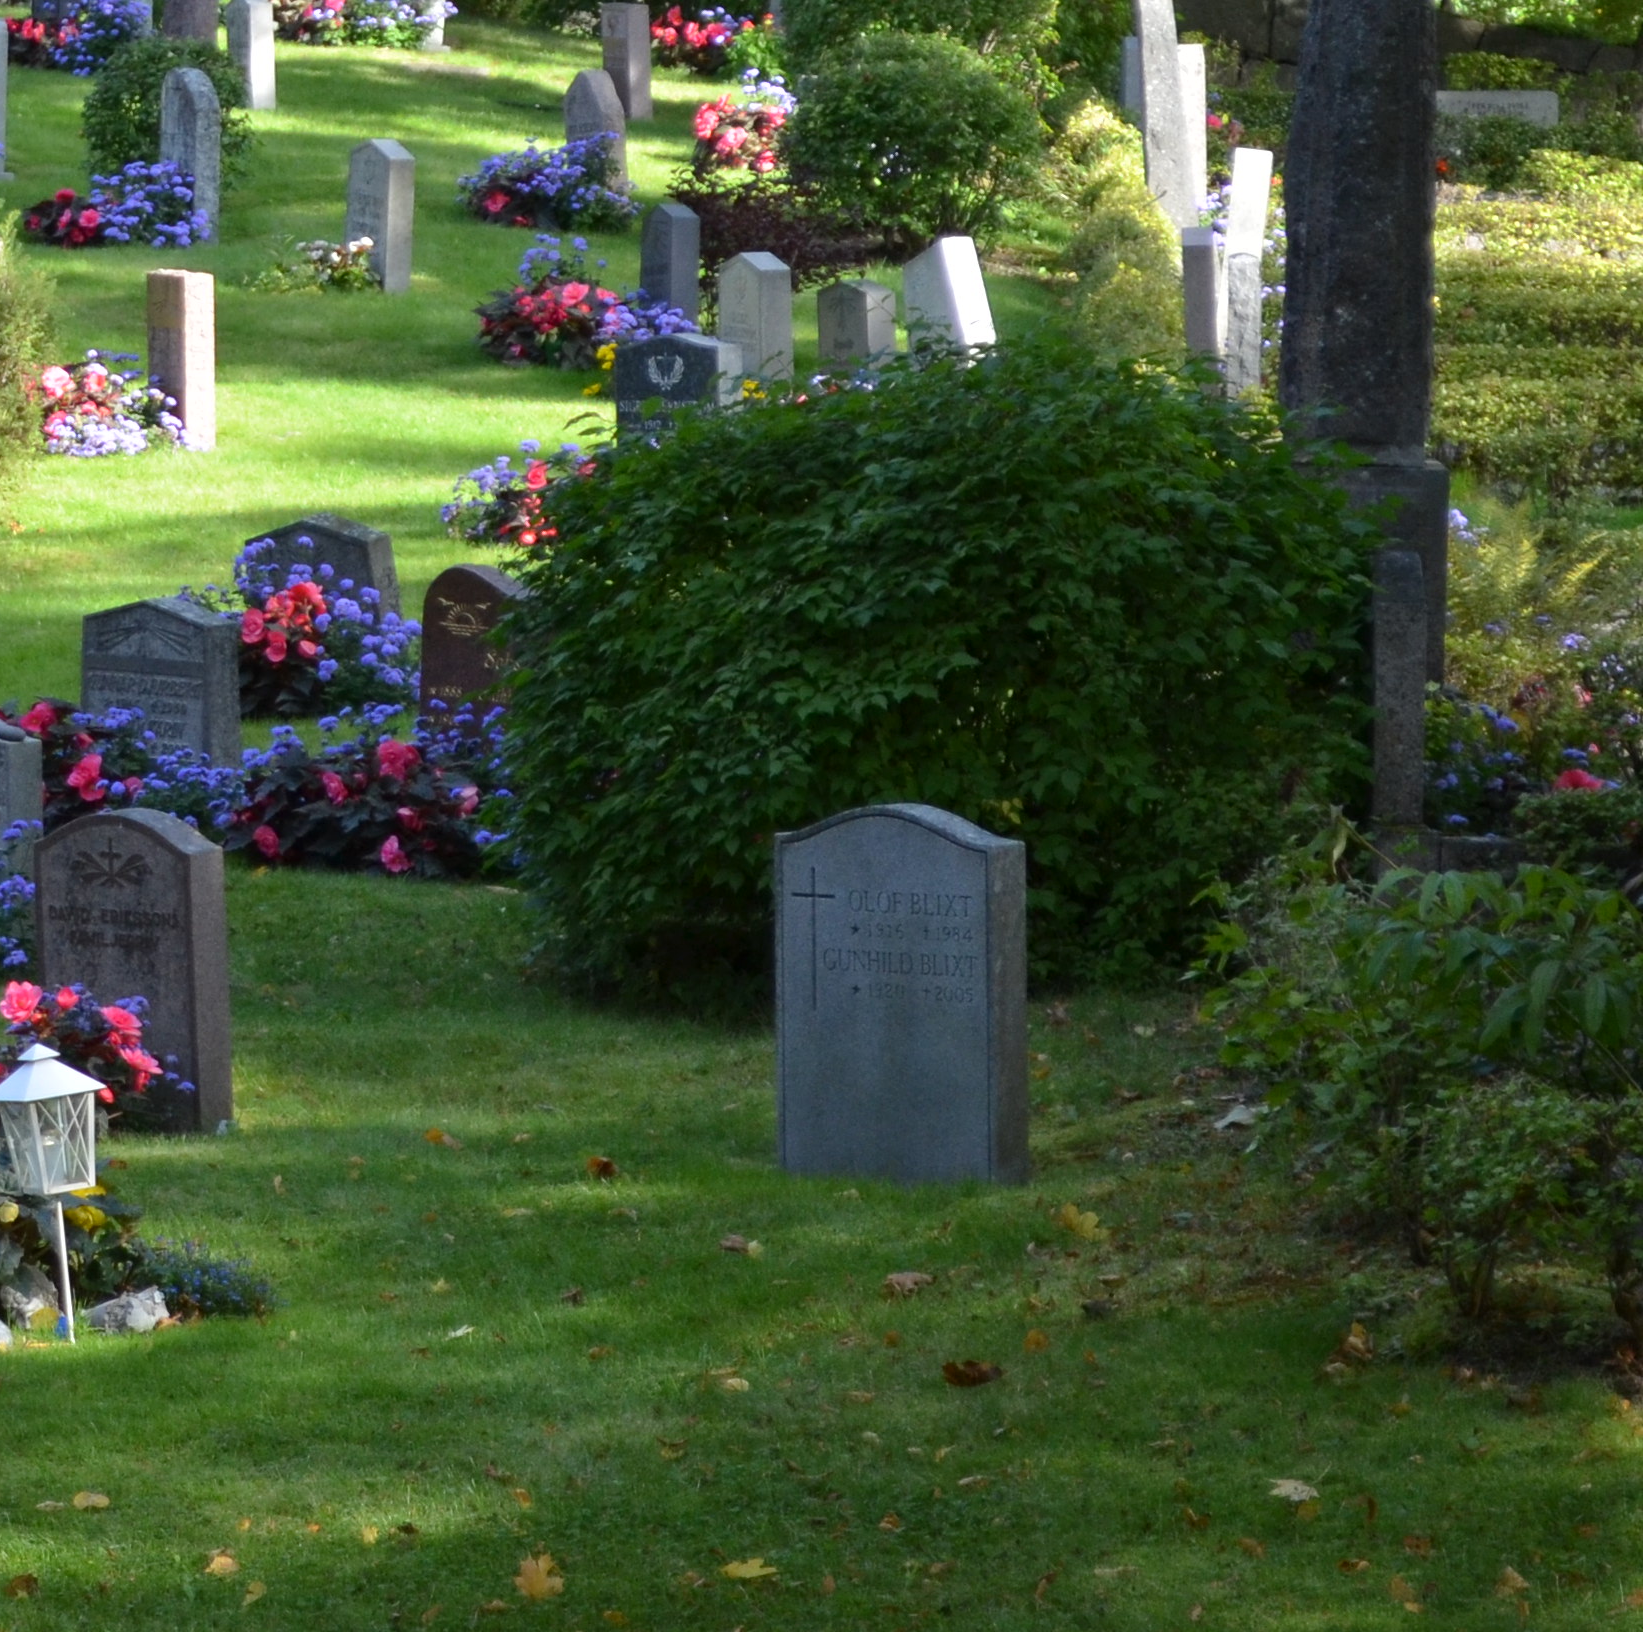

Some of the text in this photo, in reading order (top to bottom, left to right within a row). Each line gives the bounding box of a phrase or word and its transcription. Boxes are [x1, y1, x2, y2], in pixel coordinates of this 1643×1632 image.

[848, 889, 972, 917] OLOF BLIXT
[822, 947, 978, 978] GUNHILD BLIXT
